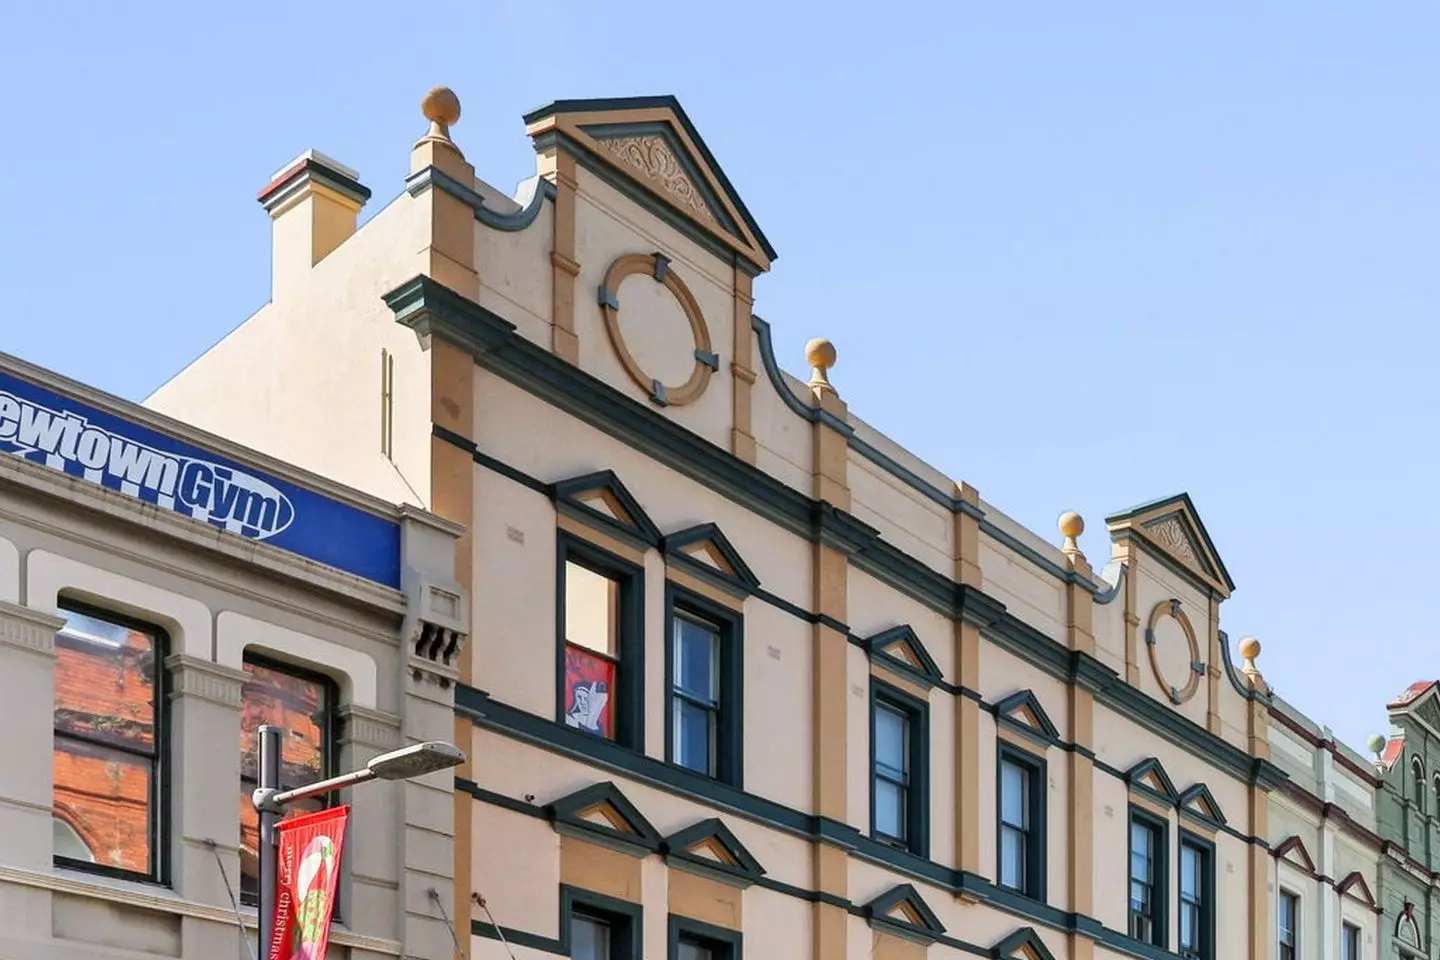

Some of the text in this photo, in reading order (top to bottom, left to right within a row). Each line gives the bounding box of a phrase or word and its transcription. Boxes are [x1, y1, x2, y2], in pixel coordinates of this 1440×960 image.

[0, 392, 279, 533] ewtown Gym
[279, 845, 293, 889] merry
[270, 892, 290, 960] christmas
